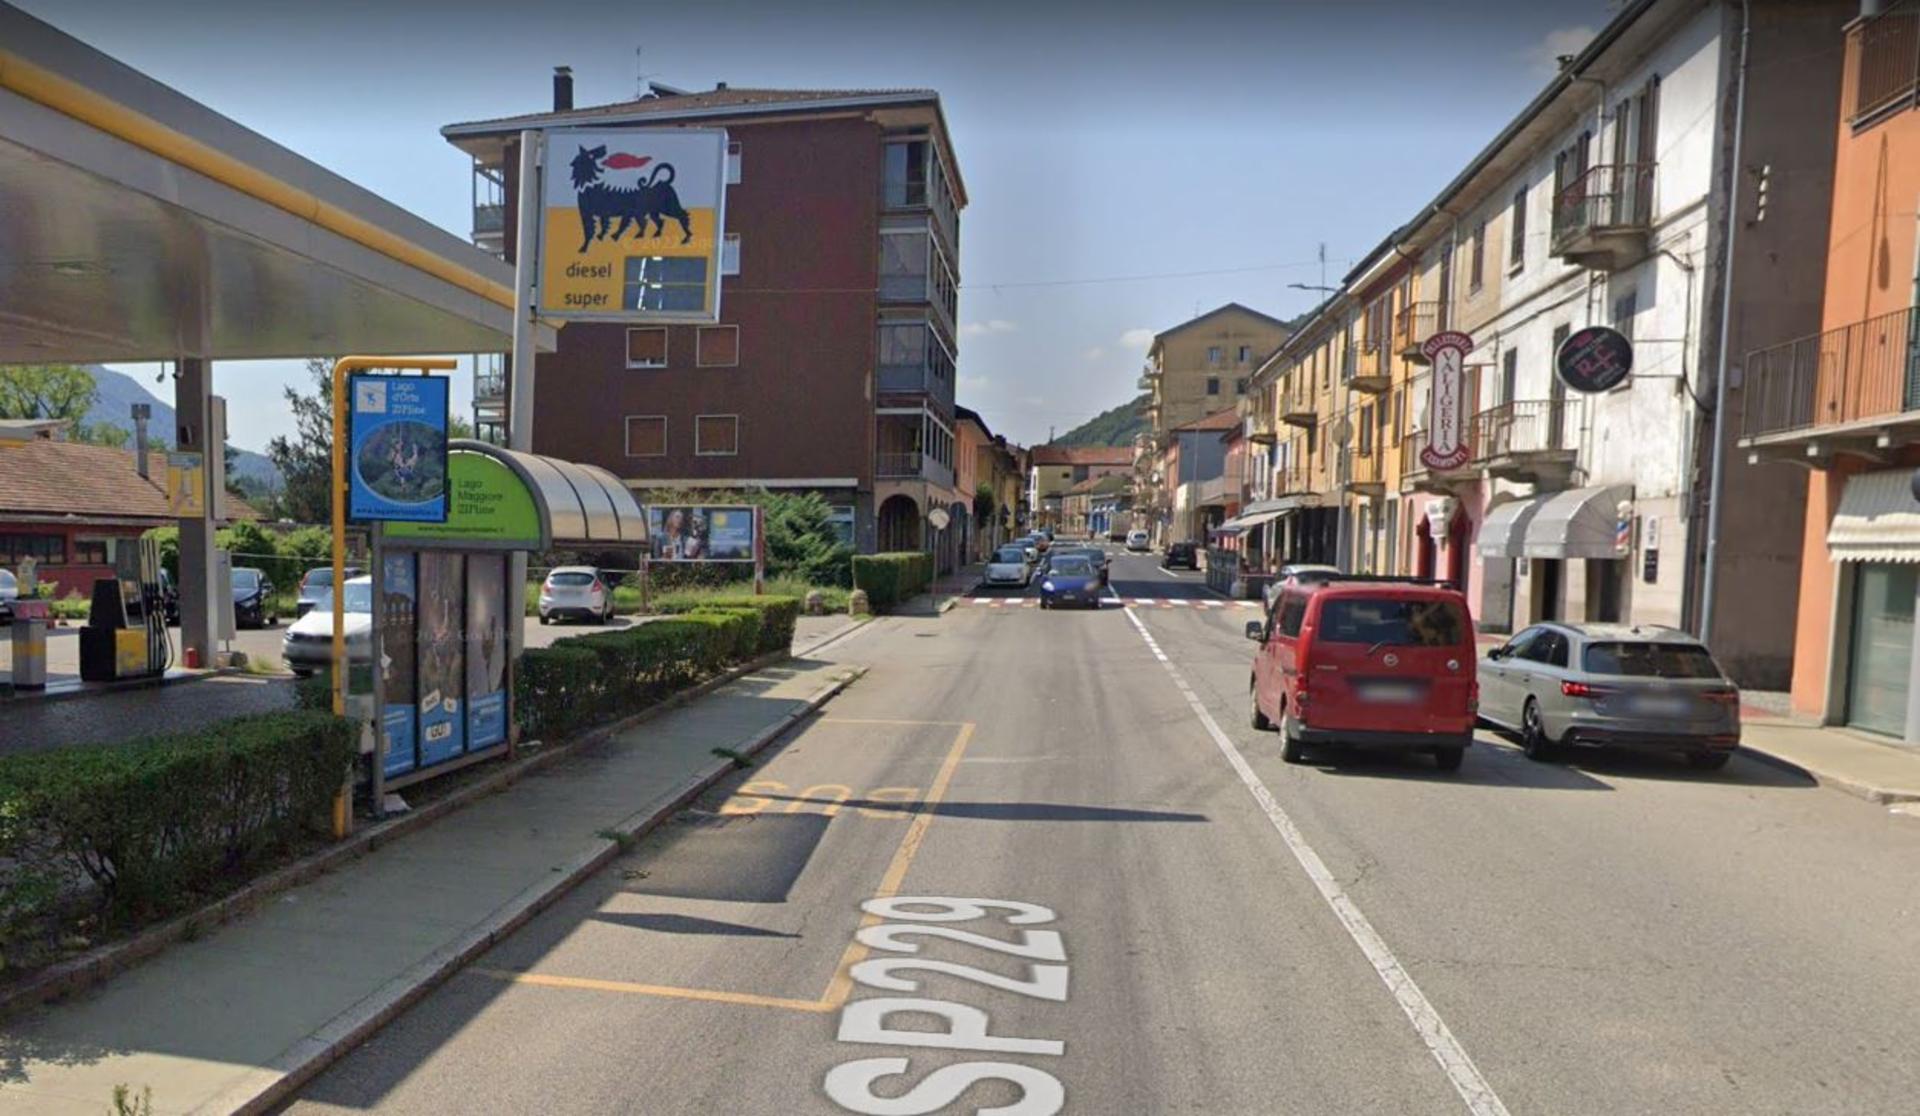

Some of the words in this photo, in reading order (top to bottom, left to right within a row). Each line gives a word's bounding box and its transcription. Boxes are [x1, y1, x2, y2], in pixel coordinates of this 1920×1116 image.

[565, 262, 612, 278] diesel
[564, 292, 609, 308] super
[391, 381, 416, 393] Lago
[1438, 350, 1456, 452] VALIGERIA
[458, 479, 484, 490] Lago
[457, 491, 504, 504] Maggiore
